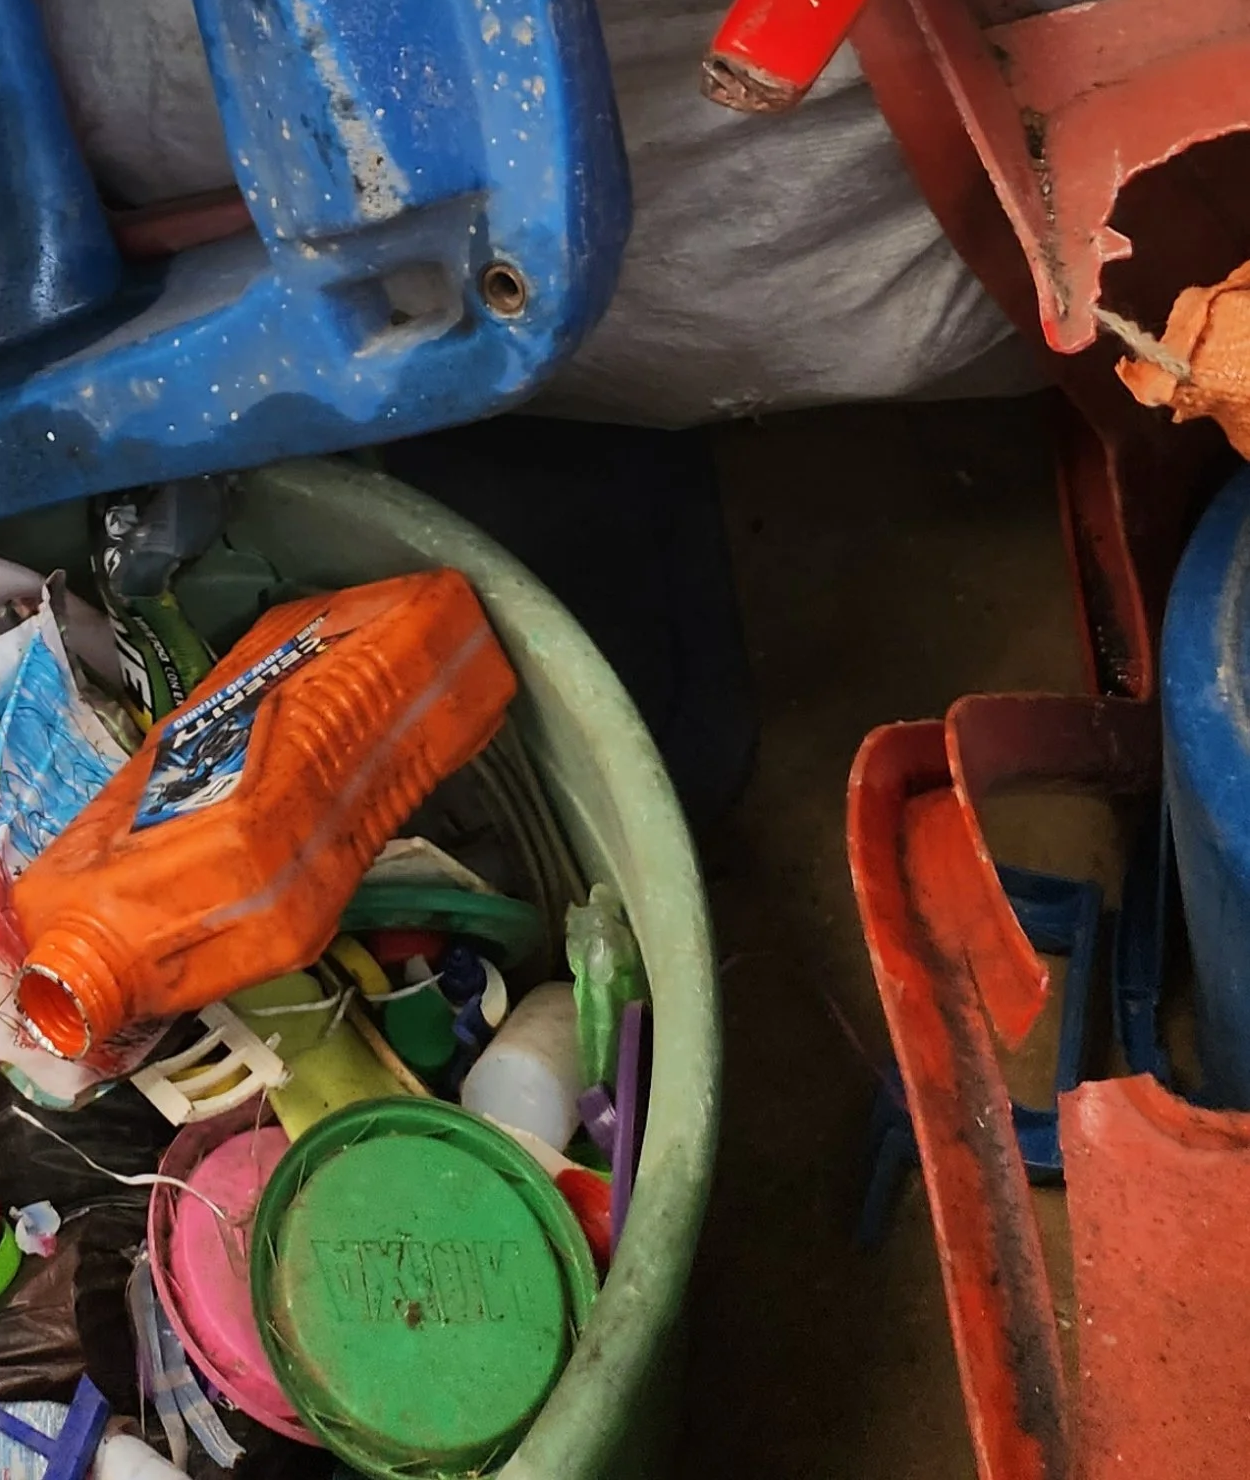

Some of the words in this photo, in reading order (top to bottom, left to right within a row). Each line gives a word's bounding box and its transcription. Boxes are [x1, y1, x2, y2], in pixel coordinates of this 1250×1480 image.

[172, 637, 321, 750] CELERITY
[226, 647, 287, 697] 20W-50
[172, 691, 226, 731] TITANIO
